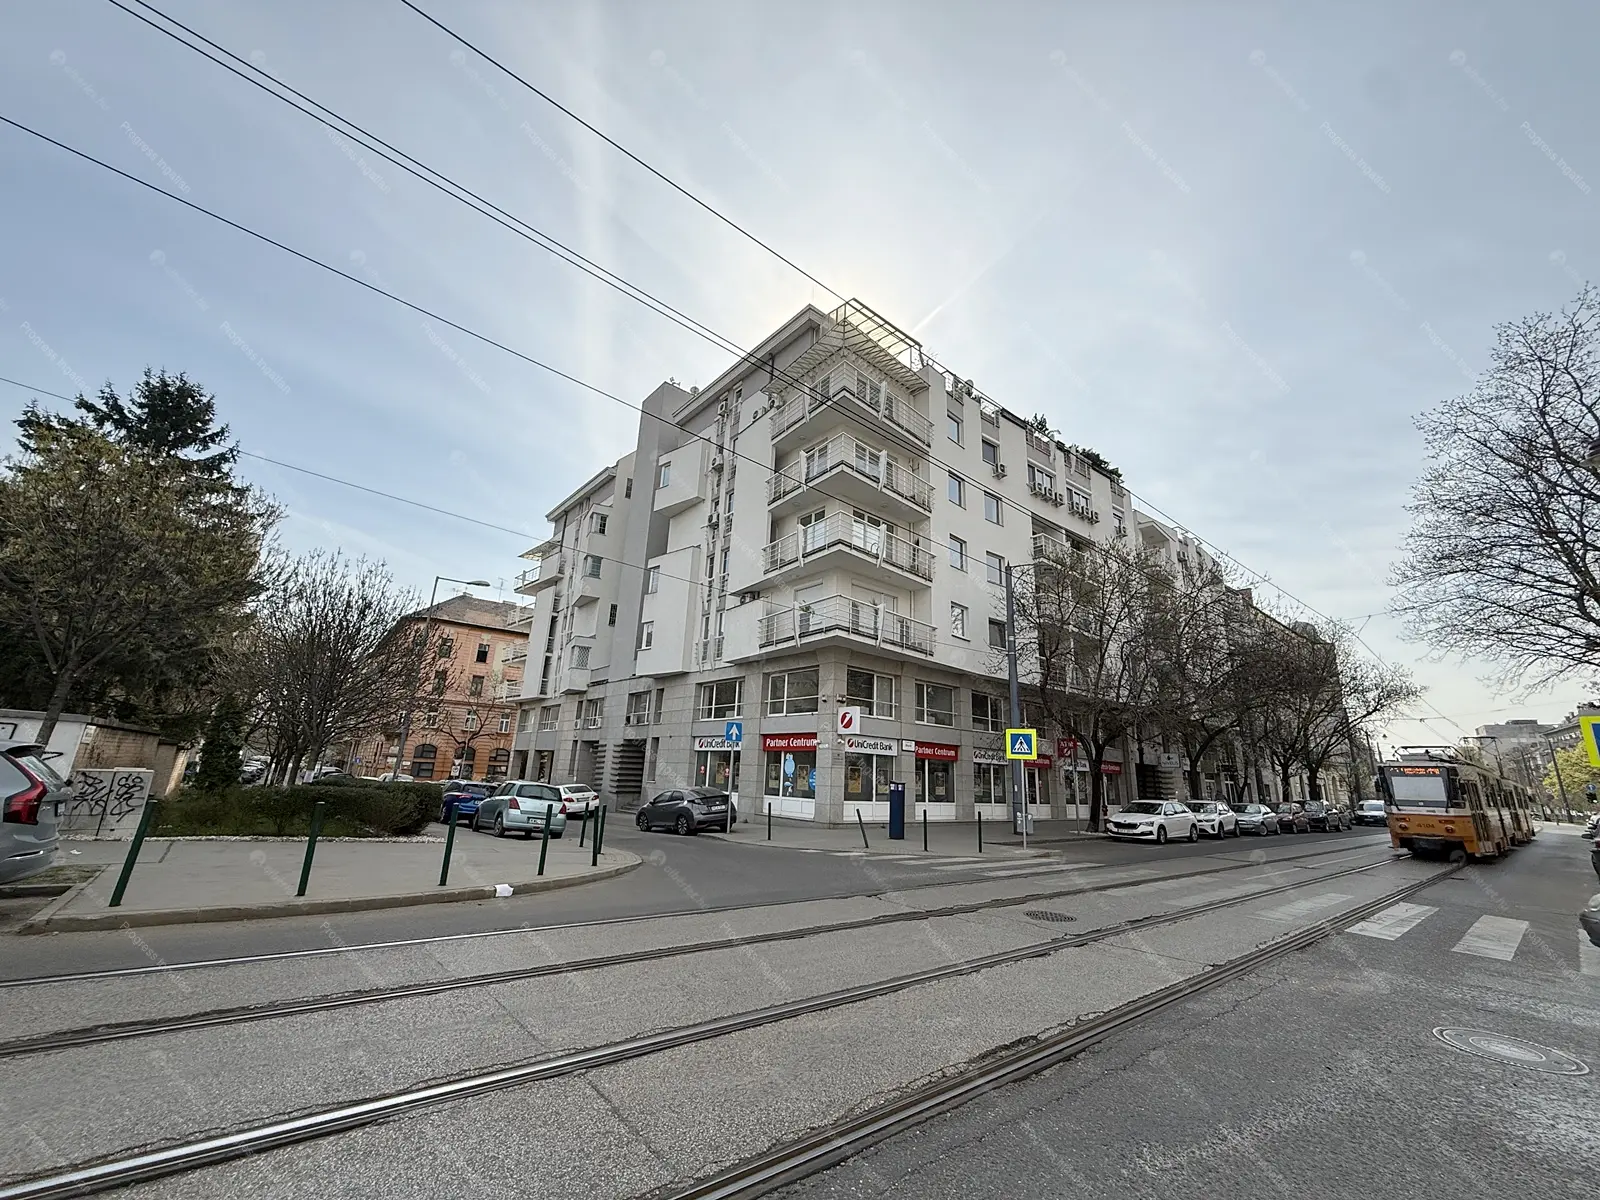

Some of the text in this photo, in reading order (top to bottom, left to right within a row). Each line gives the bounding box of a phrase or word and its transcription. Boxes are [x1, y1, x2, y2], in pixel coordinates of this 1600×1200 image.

[704, 738, 725, 749] UniCredit
[766, 737, 817, 747] Partner Centrum
[854, 739, 879, 750] UniCredit
[880, 741, 893, 751] Bank
[915, 745, 956, 757] Partner Centrum
